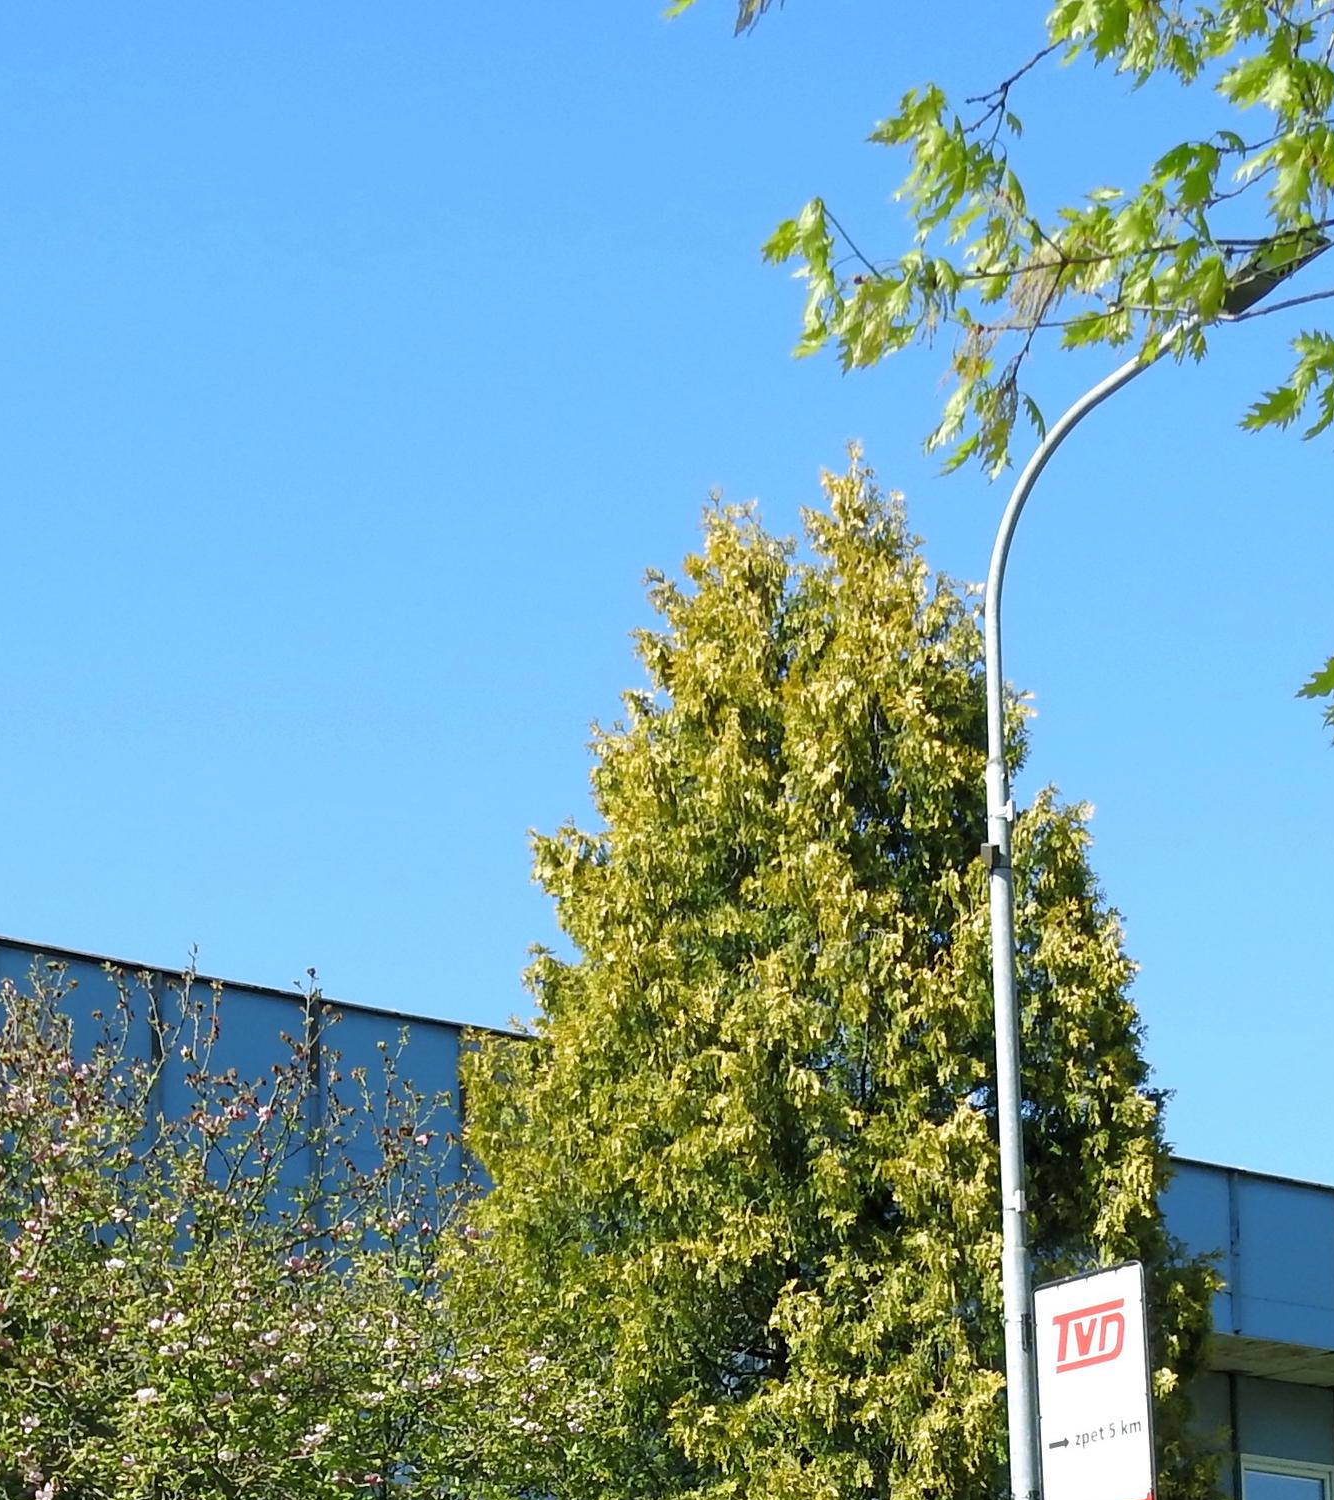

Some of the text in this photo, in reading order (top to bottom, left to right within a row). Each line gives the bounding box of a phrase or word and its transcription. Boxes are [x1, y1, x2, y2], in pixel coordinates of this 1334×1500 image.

[1052, 1298, 1126, 1375] TVD
[1109, 1422, 1117, 1439] 5
[1121, 1419, 1142, 1436] km
